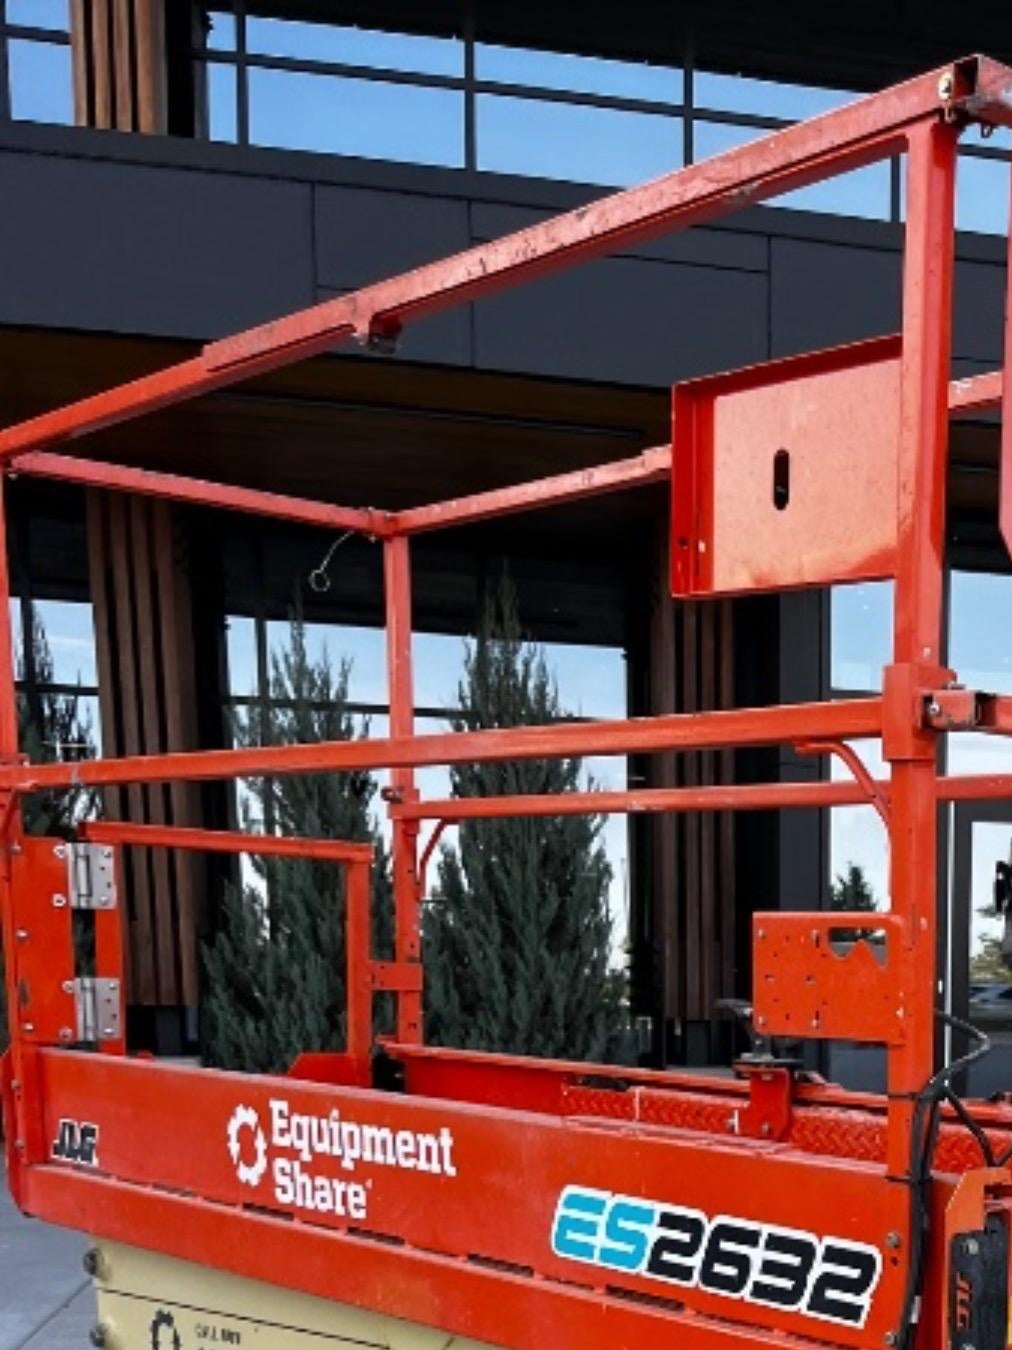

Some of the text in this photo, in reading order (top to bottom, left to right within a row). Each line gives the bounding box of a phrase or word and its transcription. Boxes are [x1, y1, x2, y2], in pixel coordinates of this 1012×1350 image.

[52, 1118, 99, 1165] JLG
[269, 1099, 457, 1176] Equipment
[273, 1157, 368, 1219] Share
[552, 1187, 882, 1327] ES2632
